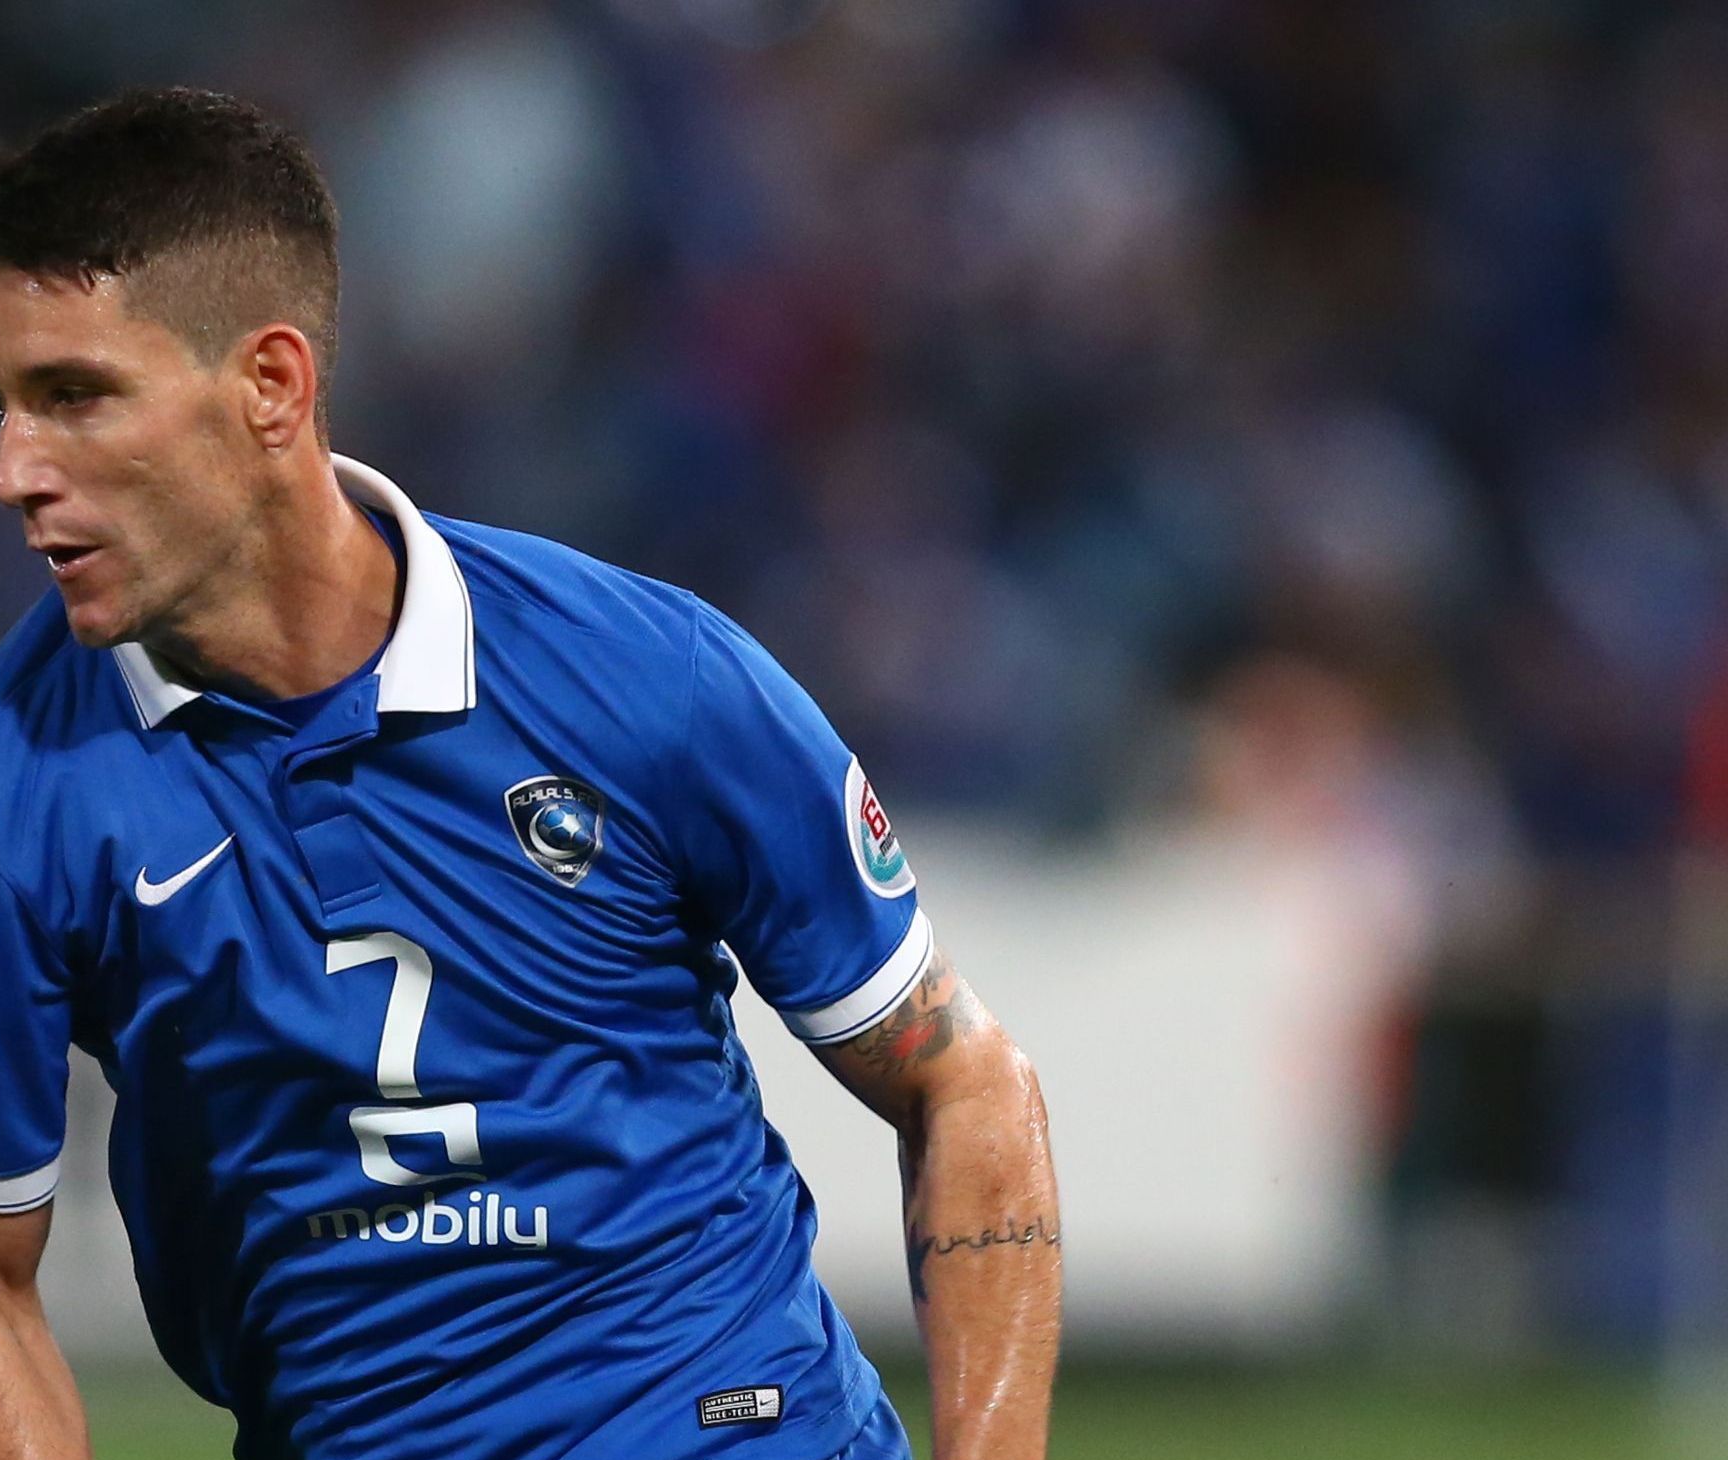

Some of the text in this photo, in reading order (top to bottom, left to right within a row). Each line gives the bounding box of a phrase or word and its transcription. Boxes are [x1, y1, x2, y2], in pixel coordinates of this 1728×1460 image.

[326, 932, 433, 1099] 7
[306, 1190, 547, 1250] mobily
[704, 1393, 753, 1406] AUTHENTIC
